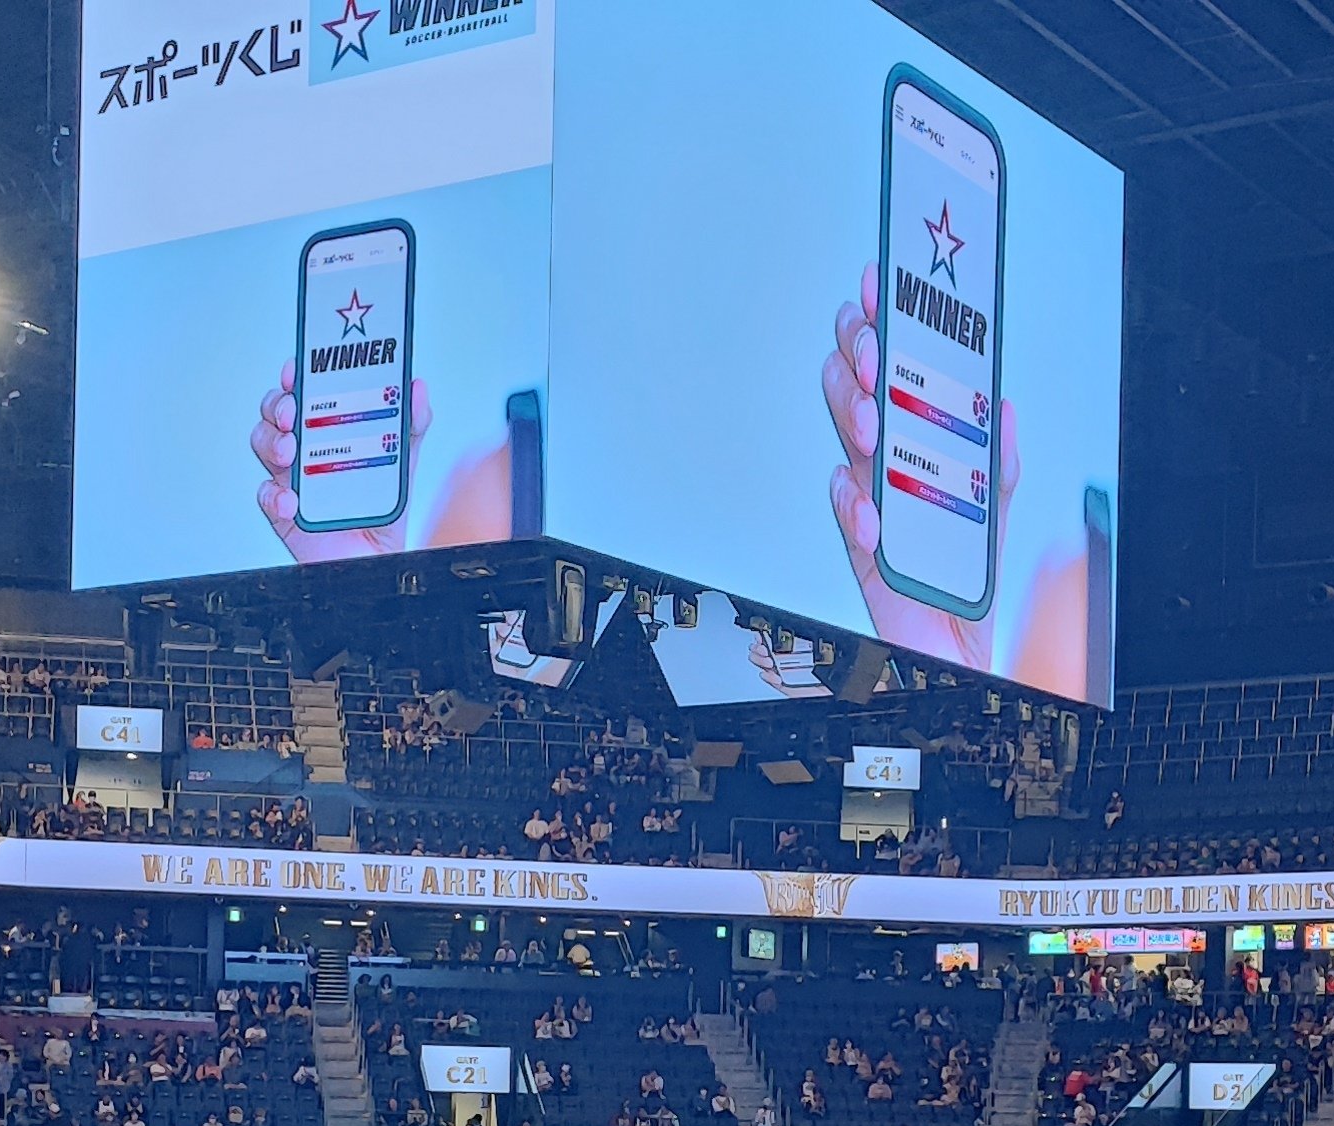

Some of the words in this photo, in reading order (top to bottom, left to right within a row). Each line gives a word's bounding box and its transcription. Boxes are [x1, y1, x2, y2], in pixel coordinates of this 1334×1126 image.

[389, 0, 523, 35] WINN
[98, 19, 303, 115] スポーツくじ
[895, 265, 988, 357] WINNER
[310, 337, 398, 374] WINNER
[895, 364, 925, 389] SOCCER
[310, 401, 338, 412] SOCCER
[893, 445, 940, 476] BASKETBALL
[110, 716, 132, 725] GATE
[100, 726, 141, 744] C41
[141, 853, 194, 885] WE
[203, 856, 272, 889] ARE
[280, 859, 357, 892] ONE.
[363, 862, 414, 895] WE
[420, 865, 486, 898] ARE
[492, 868, 599, 902] KINGS.
[998, 886, 1119, 918] RYUKYU
[1123, 884, 1241, 915] GOLDEN
[456, 1056, 479, 1065] GATE
[446, 1066, 489, 1085] C21
[1223, 1072, 1244, 1082] GATE
